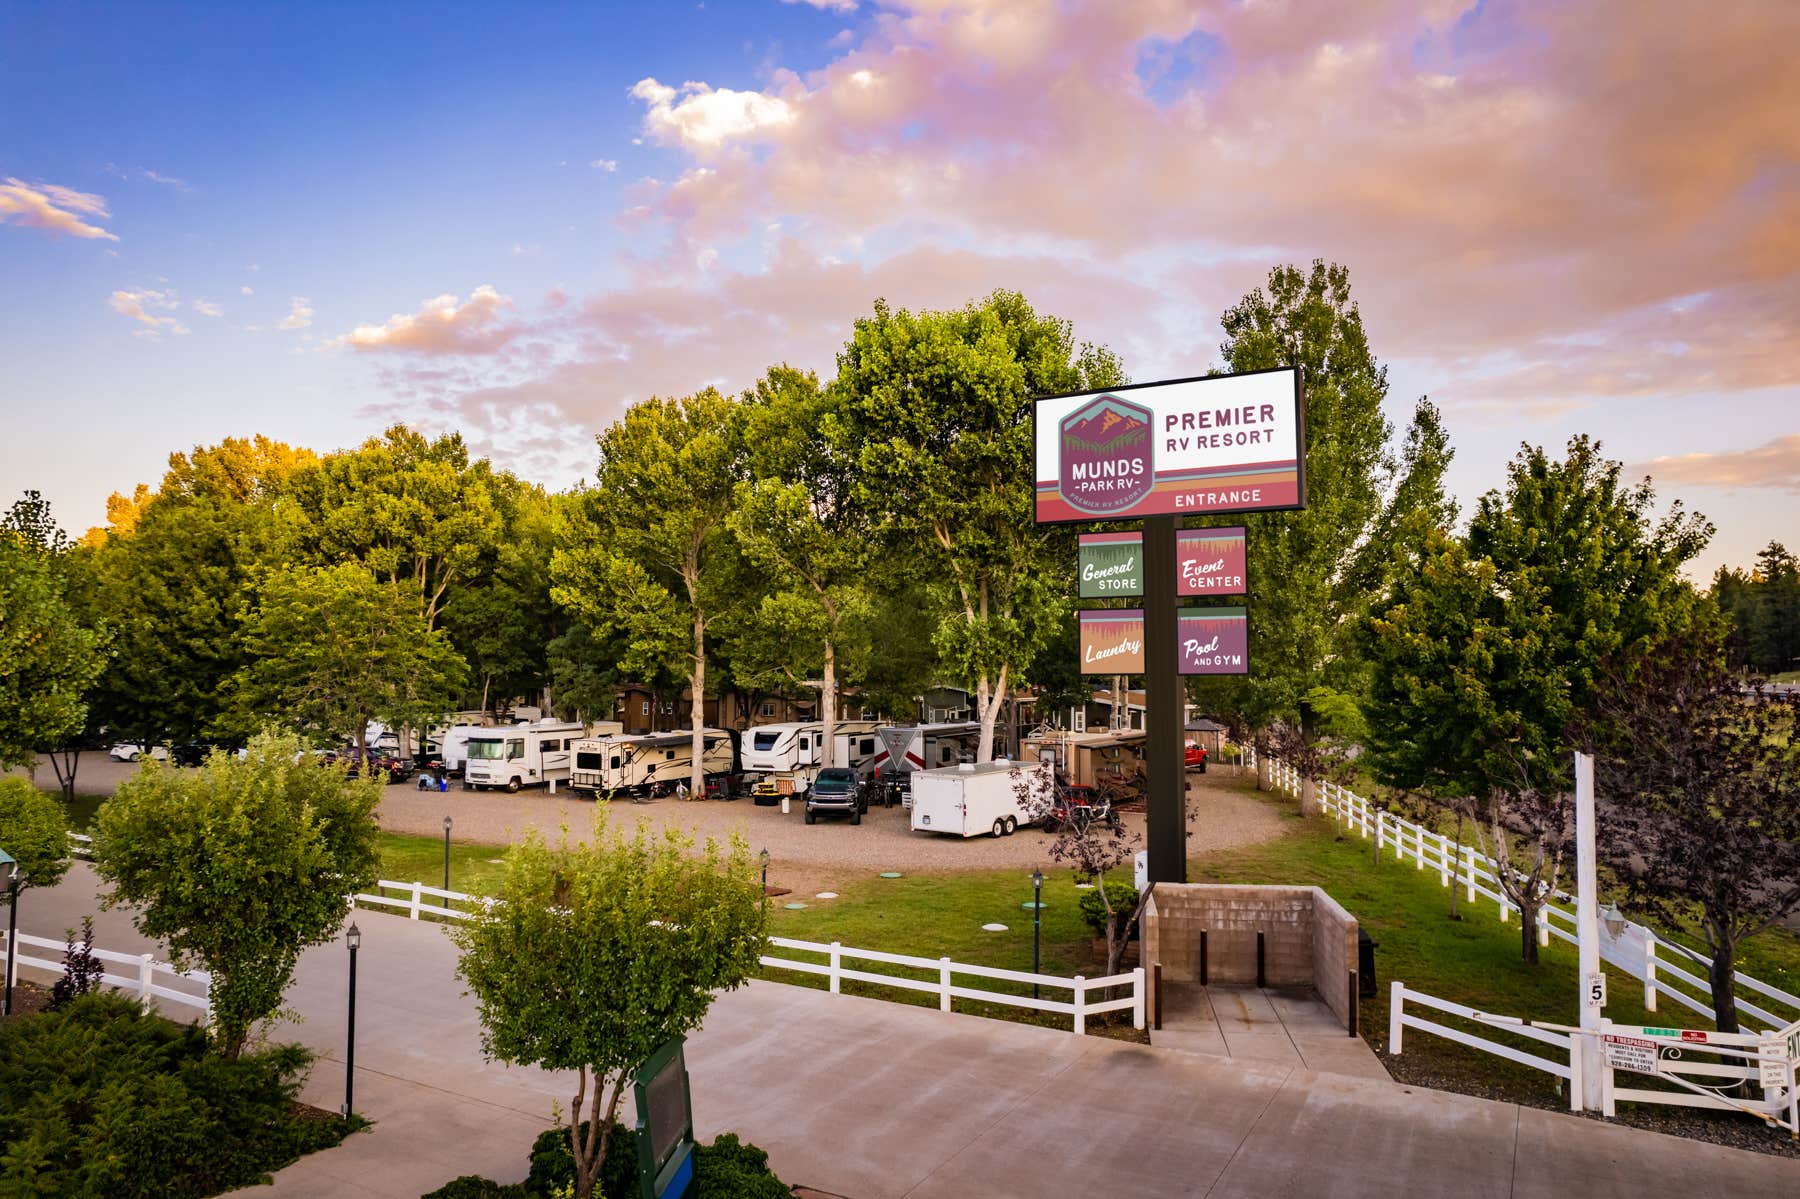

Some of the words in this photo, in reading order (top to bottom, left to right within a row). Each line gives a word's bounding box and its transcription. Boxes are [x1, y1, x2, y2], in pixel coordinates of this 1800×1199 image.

[1165, 404, 1275, 432] PREMIER
[1166, 437, 1190, 453] RV
[1197, 429, 1275, 450] RESORT
[1072, 458, 1144, 480] MUNDS
[1175, 489, 1262, 507] ENTRANCE
[1082, 557, 1134, 581] General
[1182, 558, 1225, 578] Event
[1098, 579, 1137, 590] STORE
[1189, 576, 1242, 588] CENTER
[1085, 638, 1142, 663] Laundry
[1183, 635, 1219, 659] Pool
[1193, 658, 1212, 666] AND
[1213, 655, 1241, 666] GYM
[1592, 985, 1602, 1000] 5
[1616, 1037, 1655, 1049] TRESPASSING
